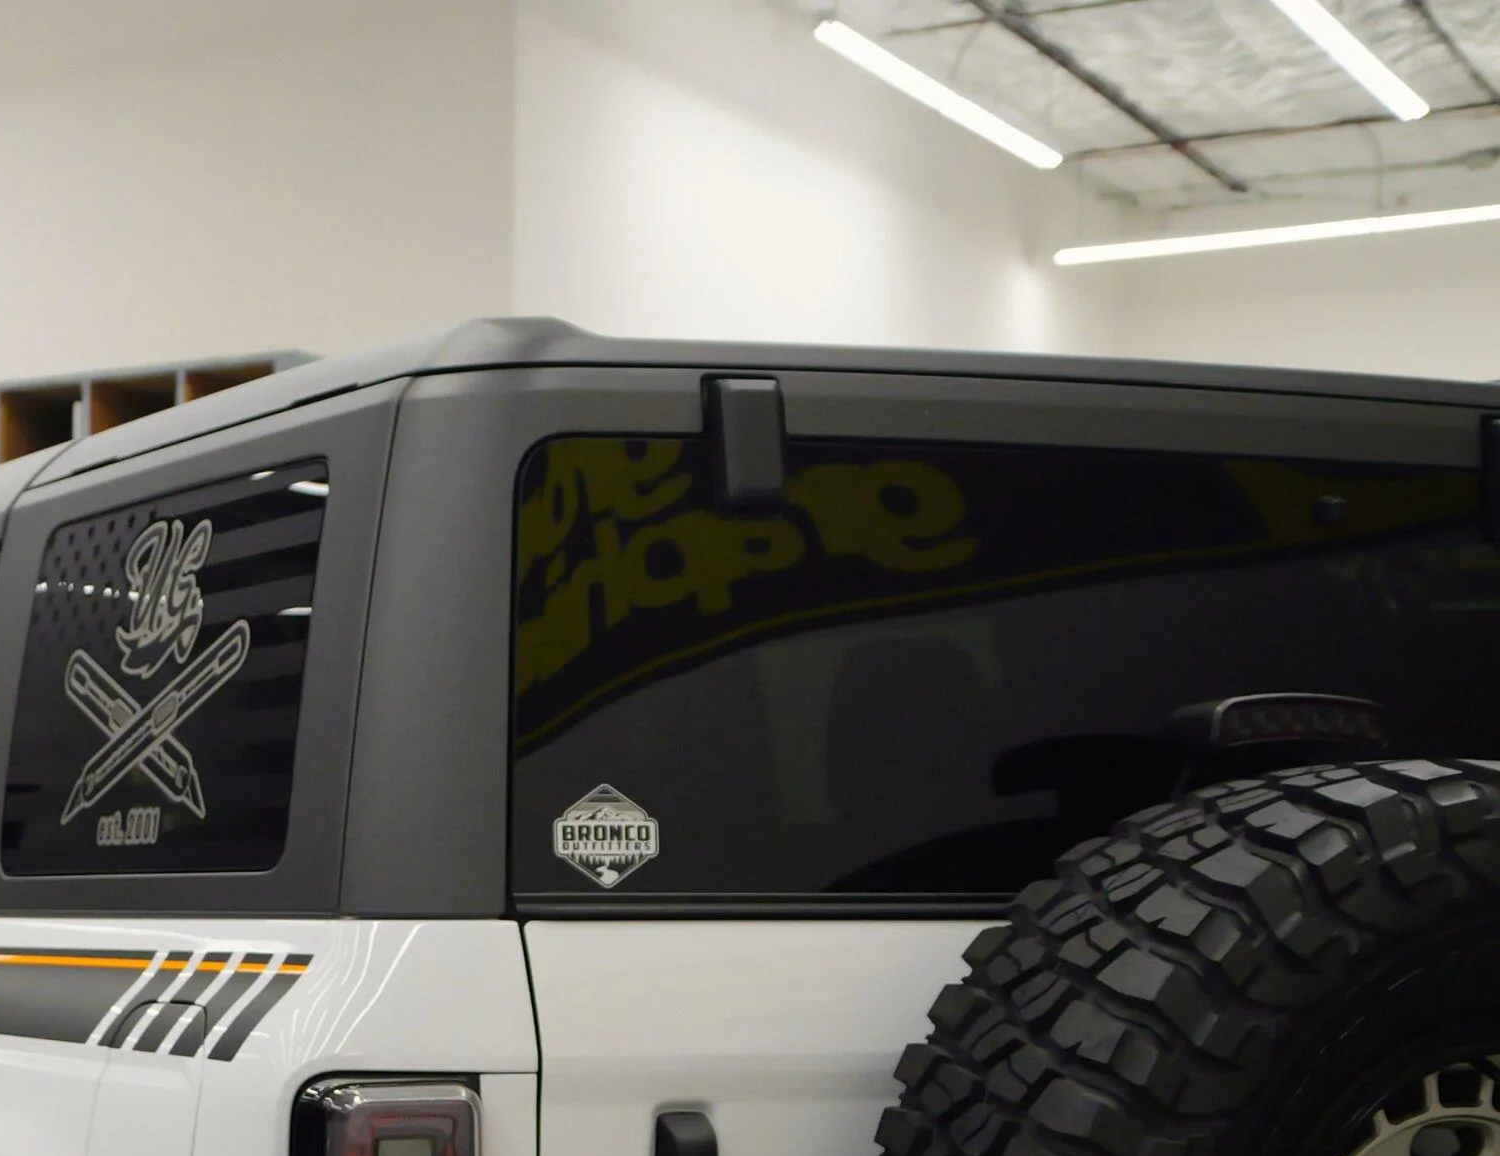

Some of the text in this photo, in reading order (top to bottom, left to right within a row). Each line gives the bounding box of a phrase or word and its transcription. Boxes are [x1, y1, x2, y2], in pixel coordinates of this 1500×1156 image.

[125, 805, 161, 846] 2001
[562, 824, 651, 842] BRONCO
[562, 841, 651, 851] OUTFITTERS
